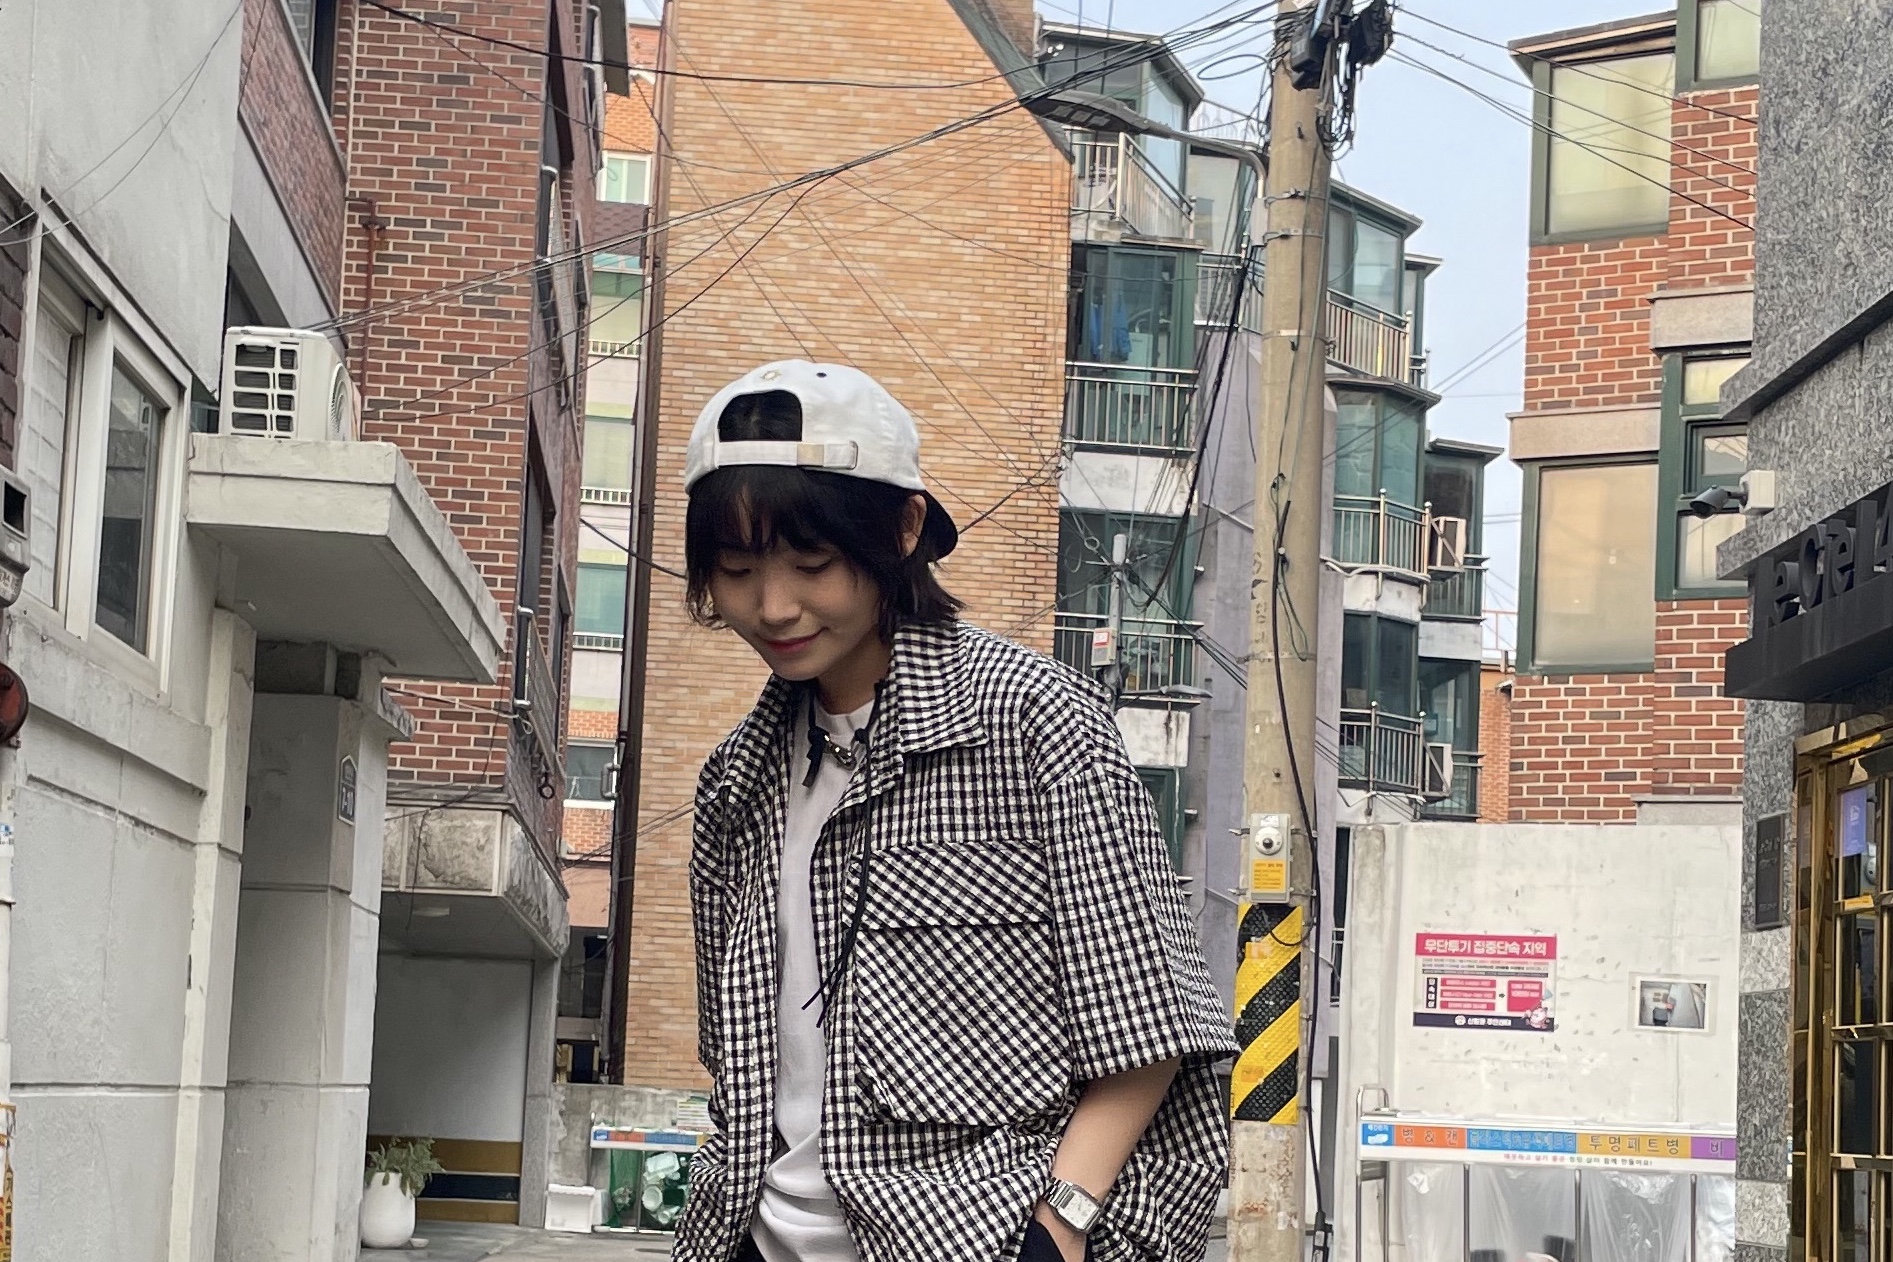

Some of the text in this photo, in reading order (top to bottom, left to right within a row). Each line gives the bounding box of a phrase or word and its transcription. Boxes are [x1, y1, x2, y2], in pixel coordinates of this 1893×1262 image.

[1424, 939, 1547, 956] 무단투기 집중단속 지역
[1402, 1128, 1458, 1146] 병 & 캔
[1589, 1135, 1680, 1155] 투명페트병
